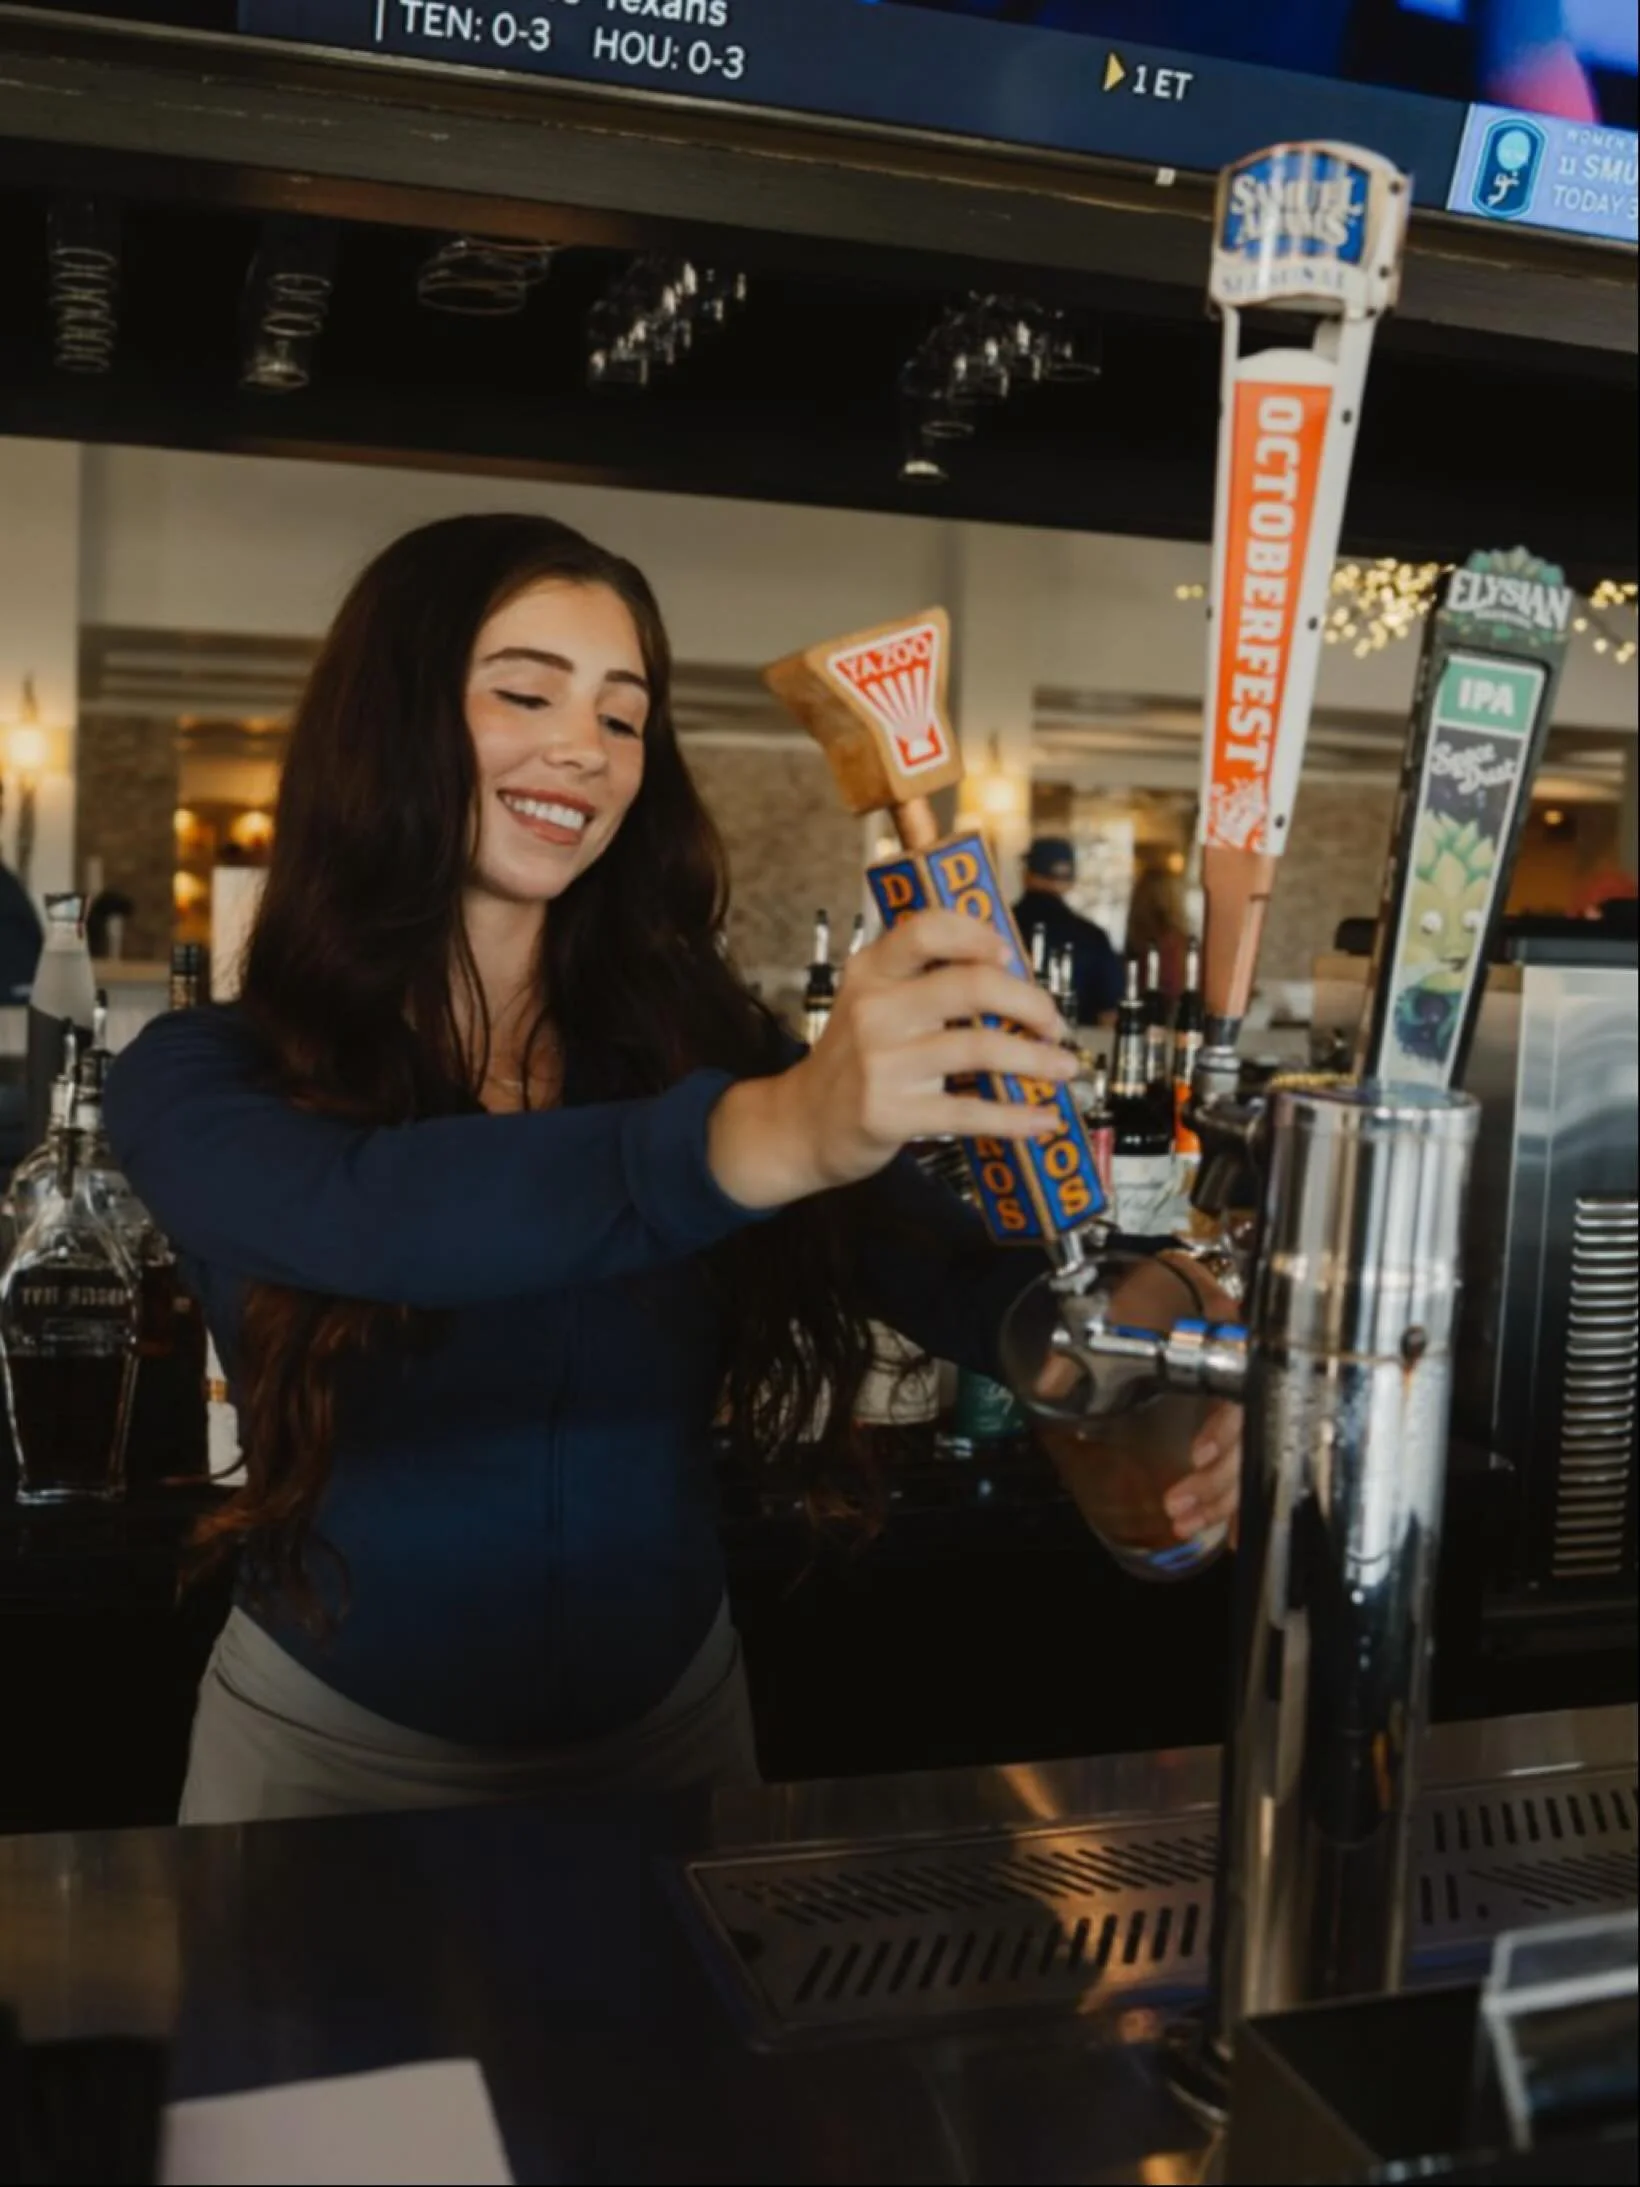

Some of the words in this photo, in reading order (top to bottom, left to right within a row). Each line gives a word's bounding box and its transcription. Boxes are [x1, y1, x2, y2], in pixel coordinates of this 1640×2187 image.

[400, 0, 483, 43] TEN:
[491, 11, 551, 51] 0-3
[592, 25, 681, 70] HOU:
[687, 40, 745, 80] 0-3
[1132, 65, 1146, 94] 1
[1153, 68, 1194, 101] ET
[1582, 154, 1638, 186] SMU
[1552, 183, 1624, 216] TODAY
[1224, 395, 1304, 774] OCTOBERFEST
[1446, 568, 1574, 632] ELYSIAN
[841, 634, 931, 682] YAZOO
[1458, 677, 1516, 717] IPA
